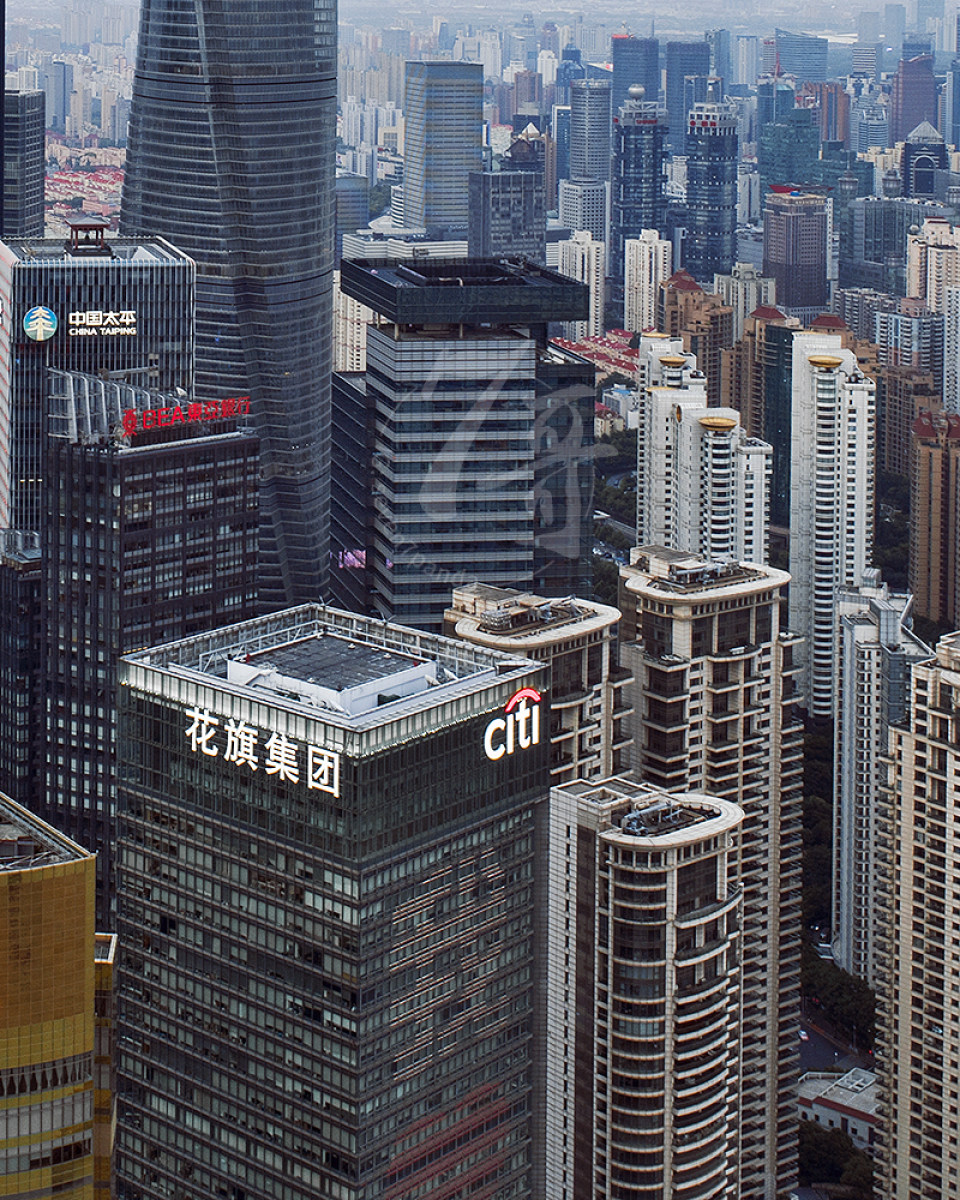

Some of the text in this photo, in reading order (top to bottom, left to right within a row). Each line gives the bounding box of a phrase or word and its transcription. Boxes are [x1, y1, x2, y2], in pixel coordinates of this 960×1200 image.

[68, 310, 137, 326] 中国太平
[68, 327, 137, 336] CHINA TAIPING
[143, 396, 251, 430] BEA 東亞銀行
[484, 698, 540, 761] citi
[184, 706, 340, 798] 花旗集团
